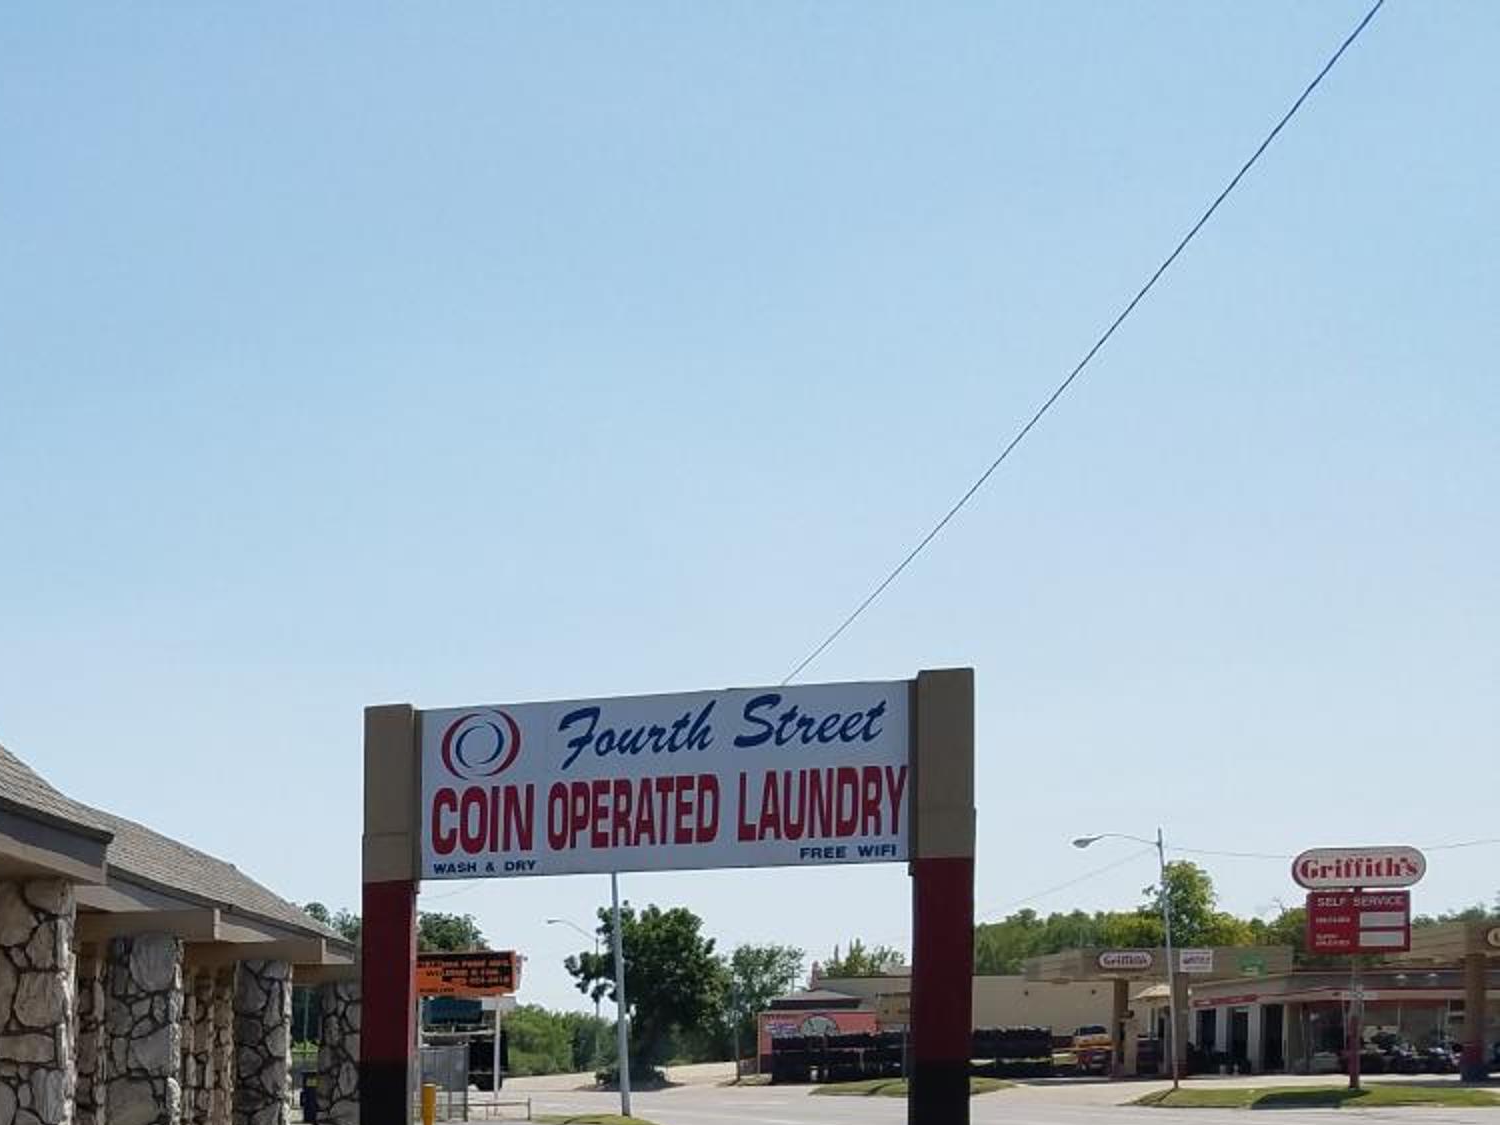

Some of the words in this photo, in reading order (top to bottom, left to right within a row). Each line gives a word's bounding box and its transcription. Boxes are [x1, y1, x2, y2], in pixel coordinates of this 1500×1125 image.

[557, 699, 717, 770] Fourth
[733, 693, 887, 748] Street
[431, 783, 535, 856] COIN
[547, 773, 721, 851] OPERATED
[736, 765, 909, 843] LAUNDRY
[799, 846, 847, 860] FREE
[857, 844, 897, 857] WIFI
[433, 861, 478, 875] WASH
[485, 861, 496, 873] &
[505, 859, 536, 872] DRY
[1300, 856, 1419, 879] Griffith's
[1316, 897, 1347, 907] SELF
[1352, 895, 1405, 907] SERVICE
